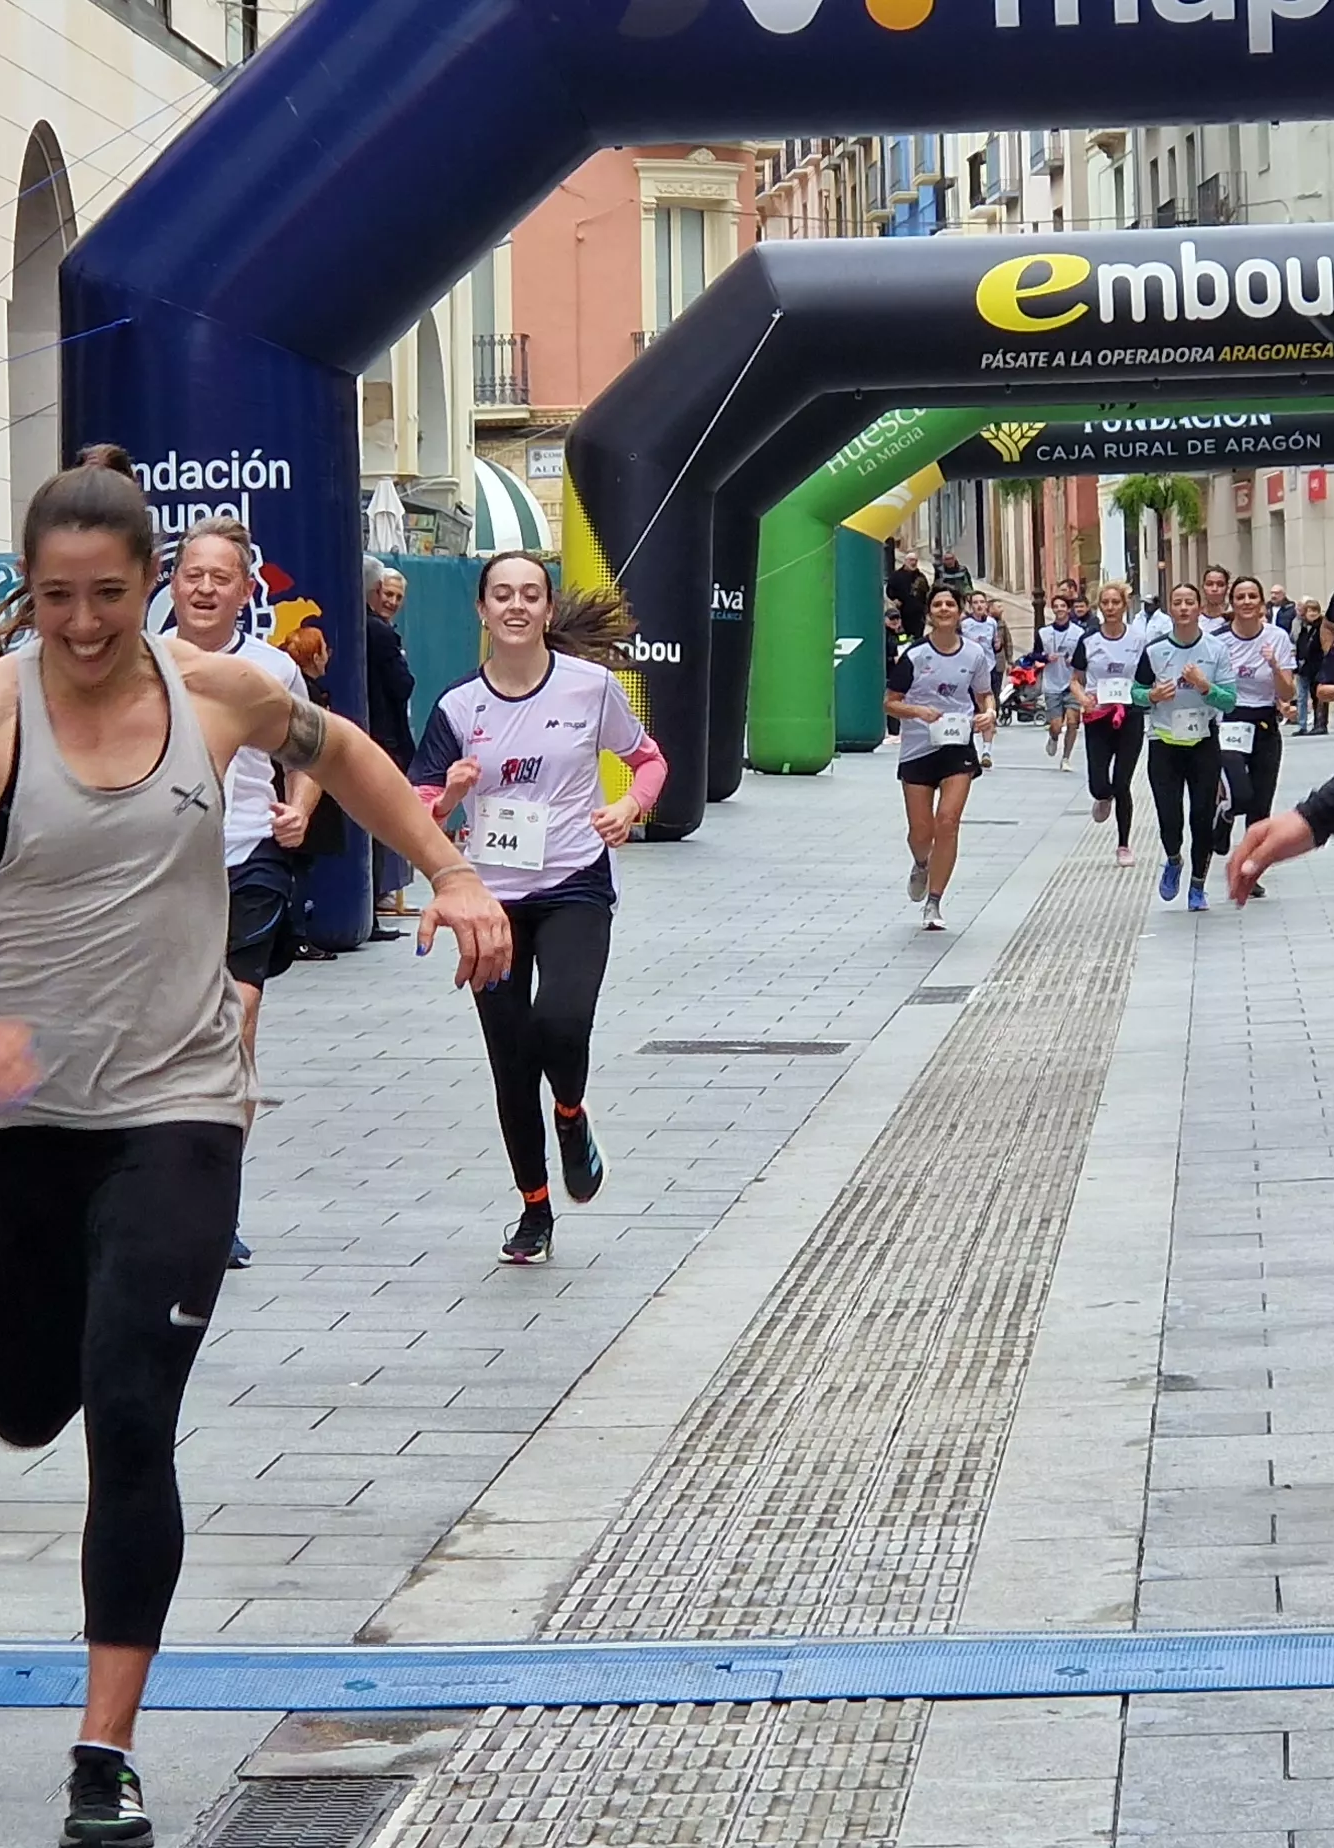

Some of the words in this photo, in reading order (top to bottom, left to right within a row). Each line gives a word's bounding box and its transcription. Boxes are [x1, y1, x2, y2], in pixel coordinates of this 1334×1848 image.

[976, 241, 1334, 332] embou
[980, 348, 1048, 370] PÁSATE
[1052, 352, 1066, 367] A
[1070, 350, 1094, 367] LA
[1097, 346, 1215, 366] OPERADORA
[1218, 342, 1334, 362] ARAGONESA
[1036, 444, 1096, 462] CAJA
[1104, 440, 1178, 459] RURAL
[1186, 439, 1218, 456] DE
[1224, 431, 1322, 453] ARAGÓN
[130, 449, 291, 492] ndación
[857, 459, 877, 477] La
[485, 832, 518, 851] 244
